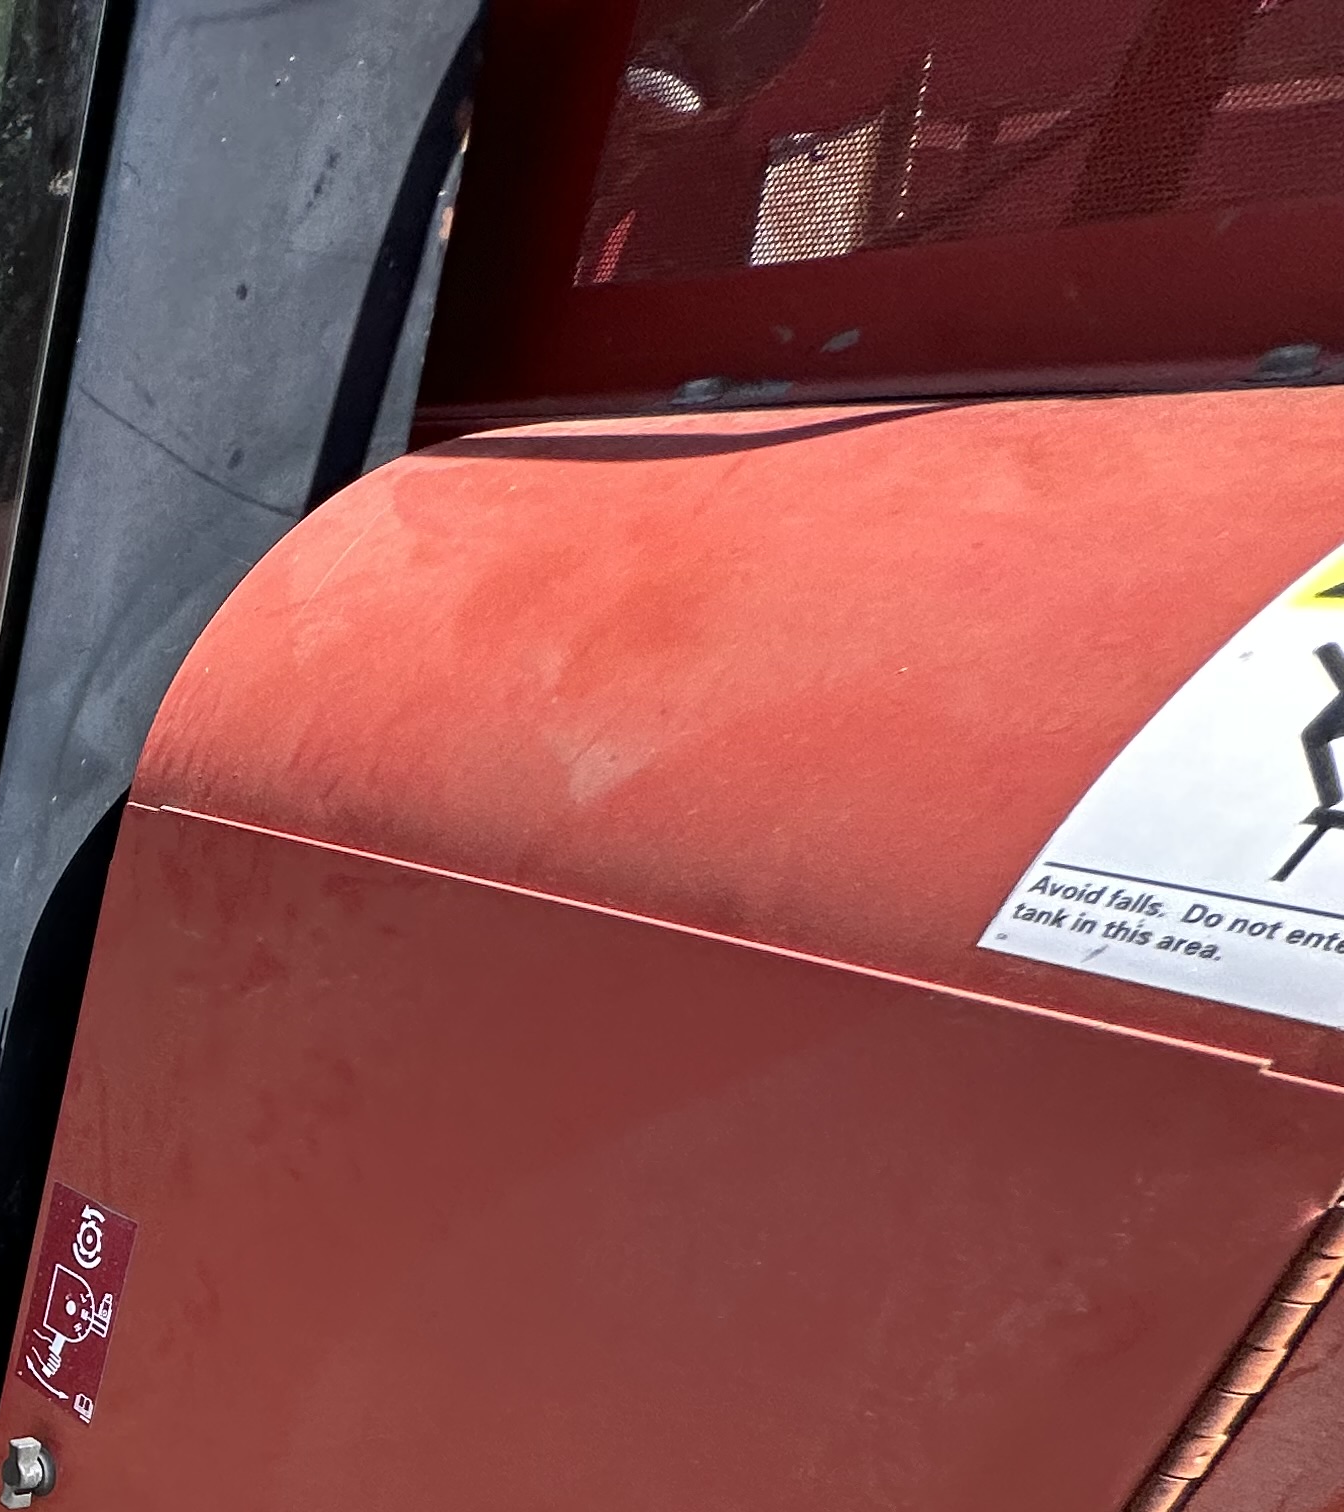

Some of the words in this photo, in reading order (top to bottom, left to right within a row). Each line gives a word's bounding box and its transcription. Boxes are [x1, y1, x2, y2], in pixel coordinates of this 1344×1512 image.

[1013, 903, 1071, 928] tank
[1070, 912, 1098, 934] in
[1101, 920, 1153, 945] this
[1155, 934, 1222, 961] area.
[1027, 875, 1110, 904] Avoid
[1105, 889, 1166, 918] falls.
[1180, 903, 1224, 928] Do
[1226, 917, 1284, 940] not
